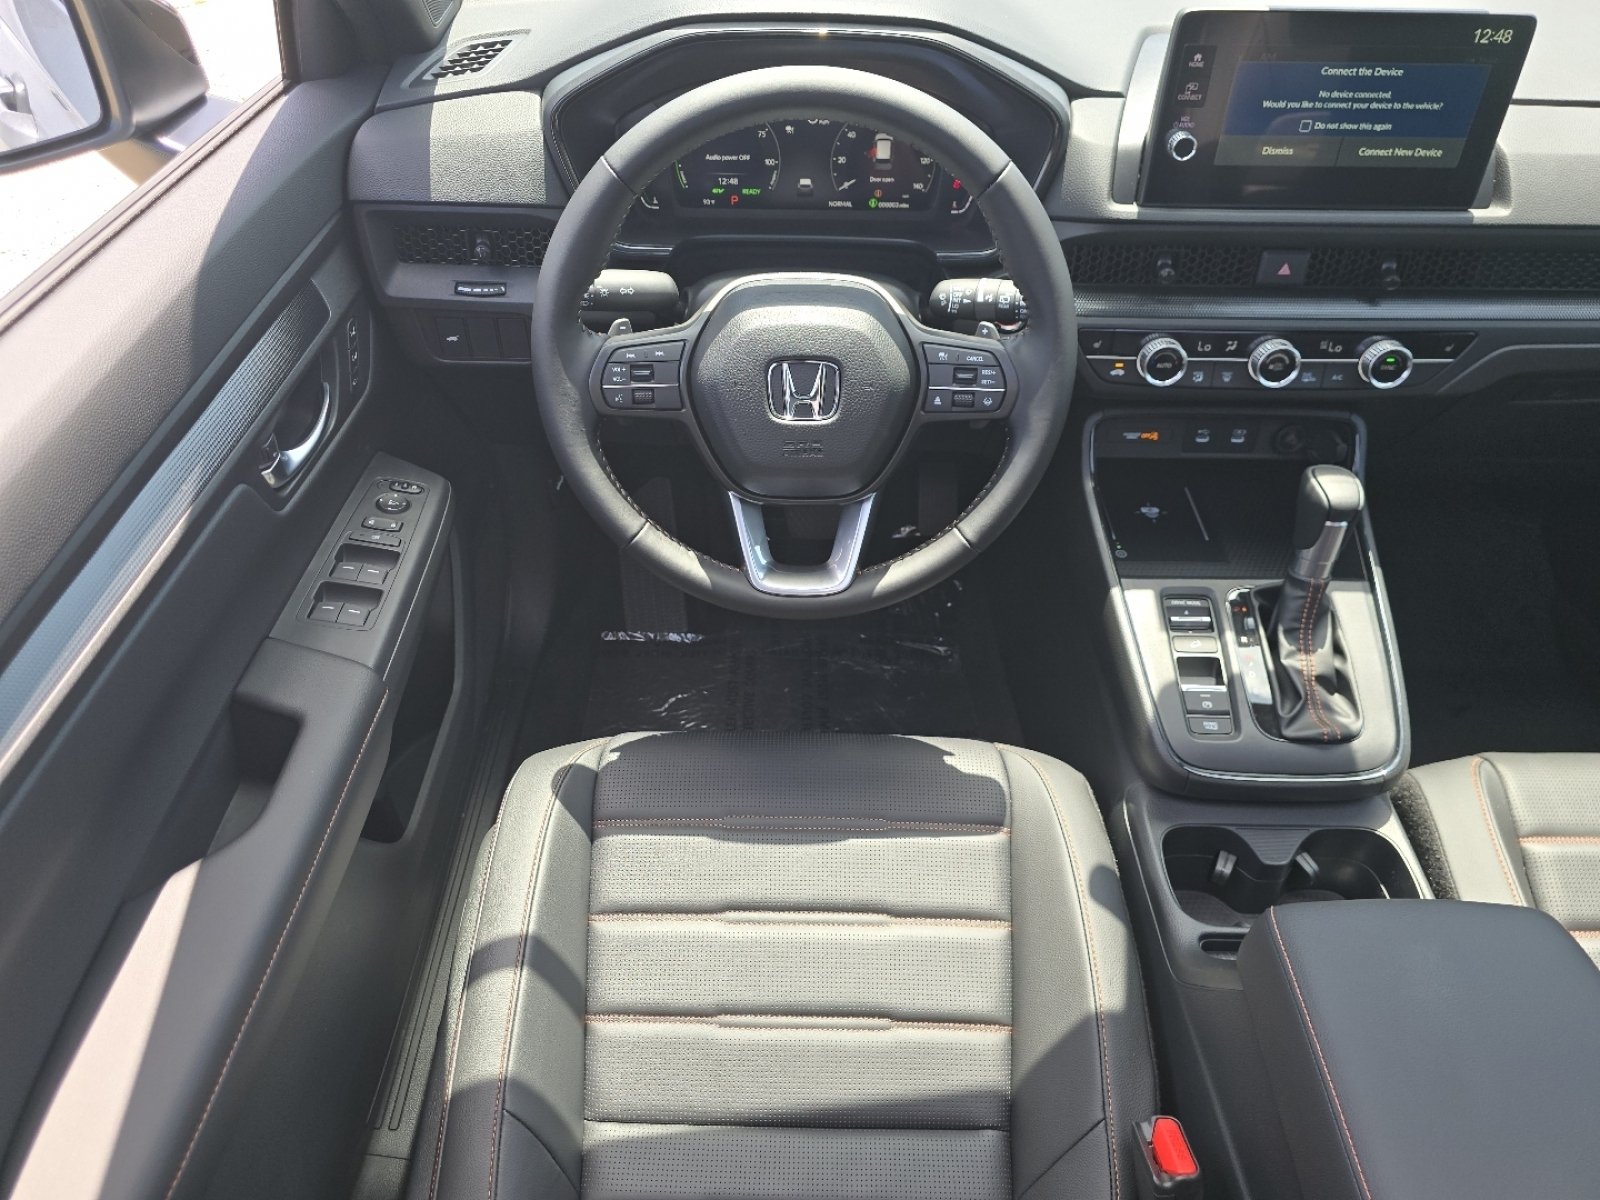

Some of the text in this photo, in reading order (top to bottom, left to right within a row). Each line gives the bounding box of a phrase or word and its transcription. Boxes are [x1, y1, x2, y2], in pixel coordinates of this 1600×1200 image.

[1474, 28, 1513, 43] 12:48
[1321, 66, 1404, 76] Connect the Device
[1319, 90, 1330, 98] No
[1263, 100, 1287, 108] Would
[1416, 102, 1444, 110] vehicle?
[1339, 122, 1358, 130] show
[1359, 122, 1372, 130] this
[1373, 123, 1392, 131] again
[758, 130, 767, 138] 75
[1262, 146, 1293, 155] Dismiss
[1359, 147, 1442, 157] Connect New Device
[838, 156, 846, 164] 20
[731, 195, 738, 205] P
[828, 200, 852, 208] NORMAL
[1198, 342, 1211, 351] Lo
[1328, 342, 1342, 352] Lo
